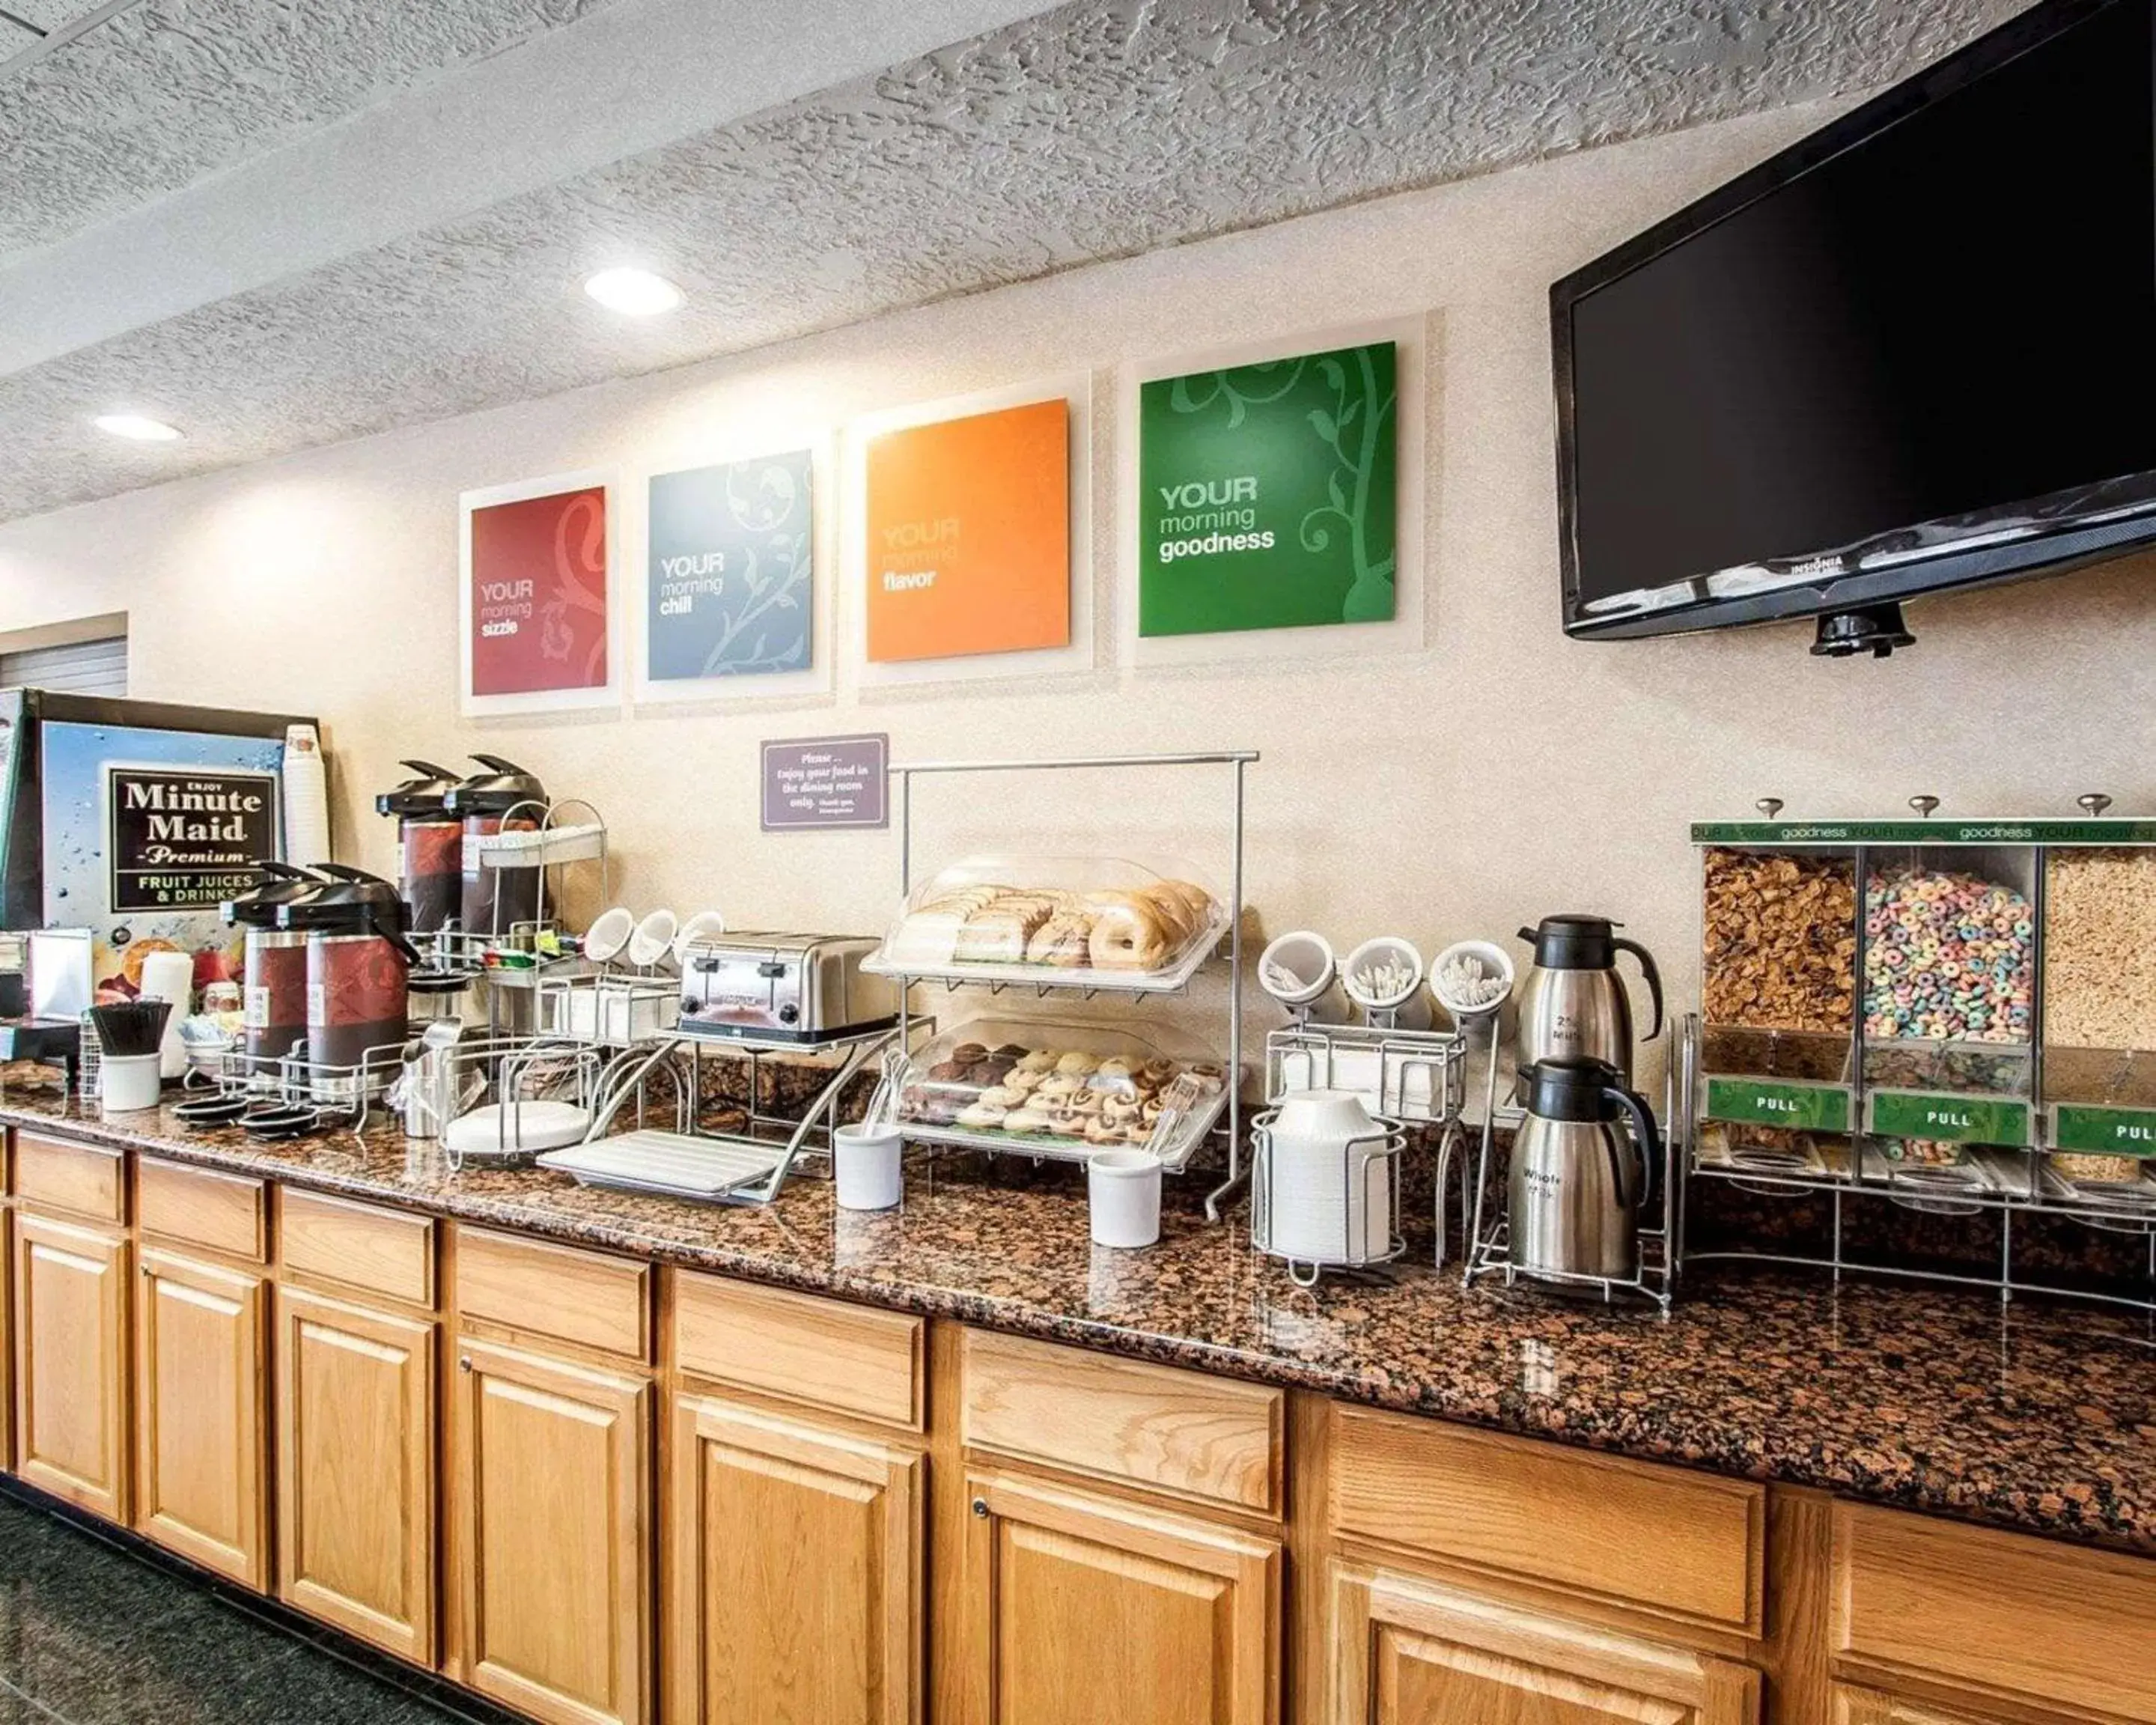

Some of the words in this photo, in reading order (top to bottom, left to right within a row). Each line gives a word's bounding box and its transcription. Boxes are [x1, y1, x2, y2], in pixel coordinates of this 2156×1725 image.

[1160, 477, 1258, 511] YOUR
[1160, 506, 1255, 534] morning
[883, 518, 959, 547] YOUR
[1160, 531, 1275, 563] goodness
[661, 553, 724, 579] YOUR
[481, 579, 533, 602] YOUR
[661, 574, 722, 597] morning
[883, 571, 937, 591] flavor
[481, 602, 532, 621] morning
[660, 595, 692, 615] chill
[481, 618, 519, 637] sizzle
[801, 752, 832, 764] Please
[777, 768, 805, 782] Enjoy
[806, 768, 830, 780] your
[832, 764, 856, 779] food
[857, 764, 868, 776] in
[187, 782, 222, 792] ENJOY
[800, 781, 834, 794] dining
[835, 782, 863, 791] room
[124, 782, 262, 812] Minute
[146, 814, 244, 842] Maid
[1781, 827, 1847, 839] goodness
[1850, 826, 1893, 837] YOUR
[1960, 827, 2032, 839] goodness
[2034, 825, 2083, 838] YOUR
[138, 876, 191, 889] FRUIT
[197, 874, 253, 888] JUICES
[157, 890, 169, 902] &
[175, 888, 237, 901] DRINKS
[1757, 1097, 1797, 1112] PULL
[1927, 1111, 1970, 1126] PULL
[2116, 1125, 2156, 1140] PUL
